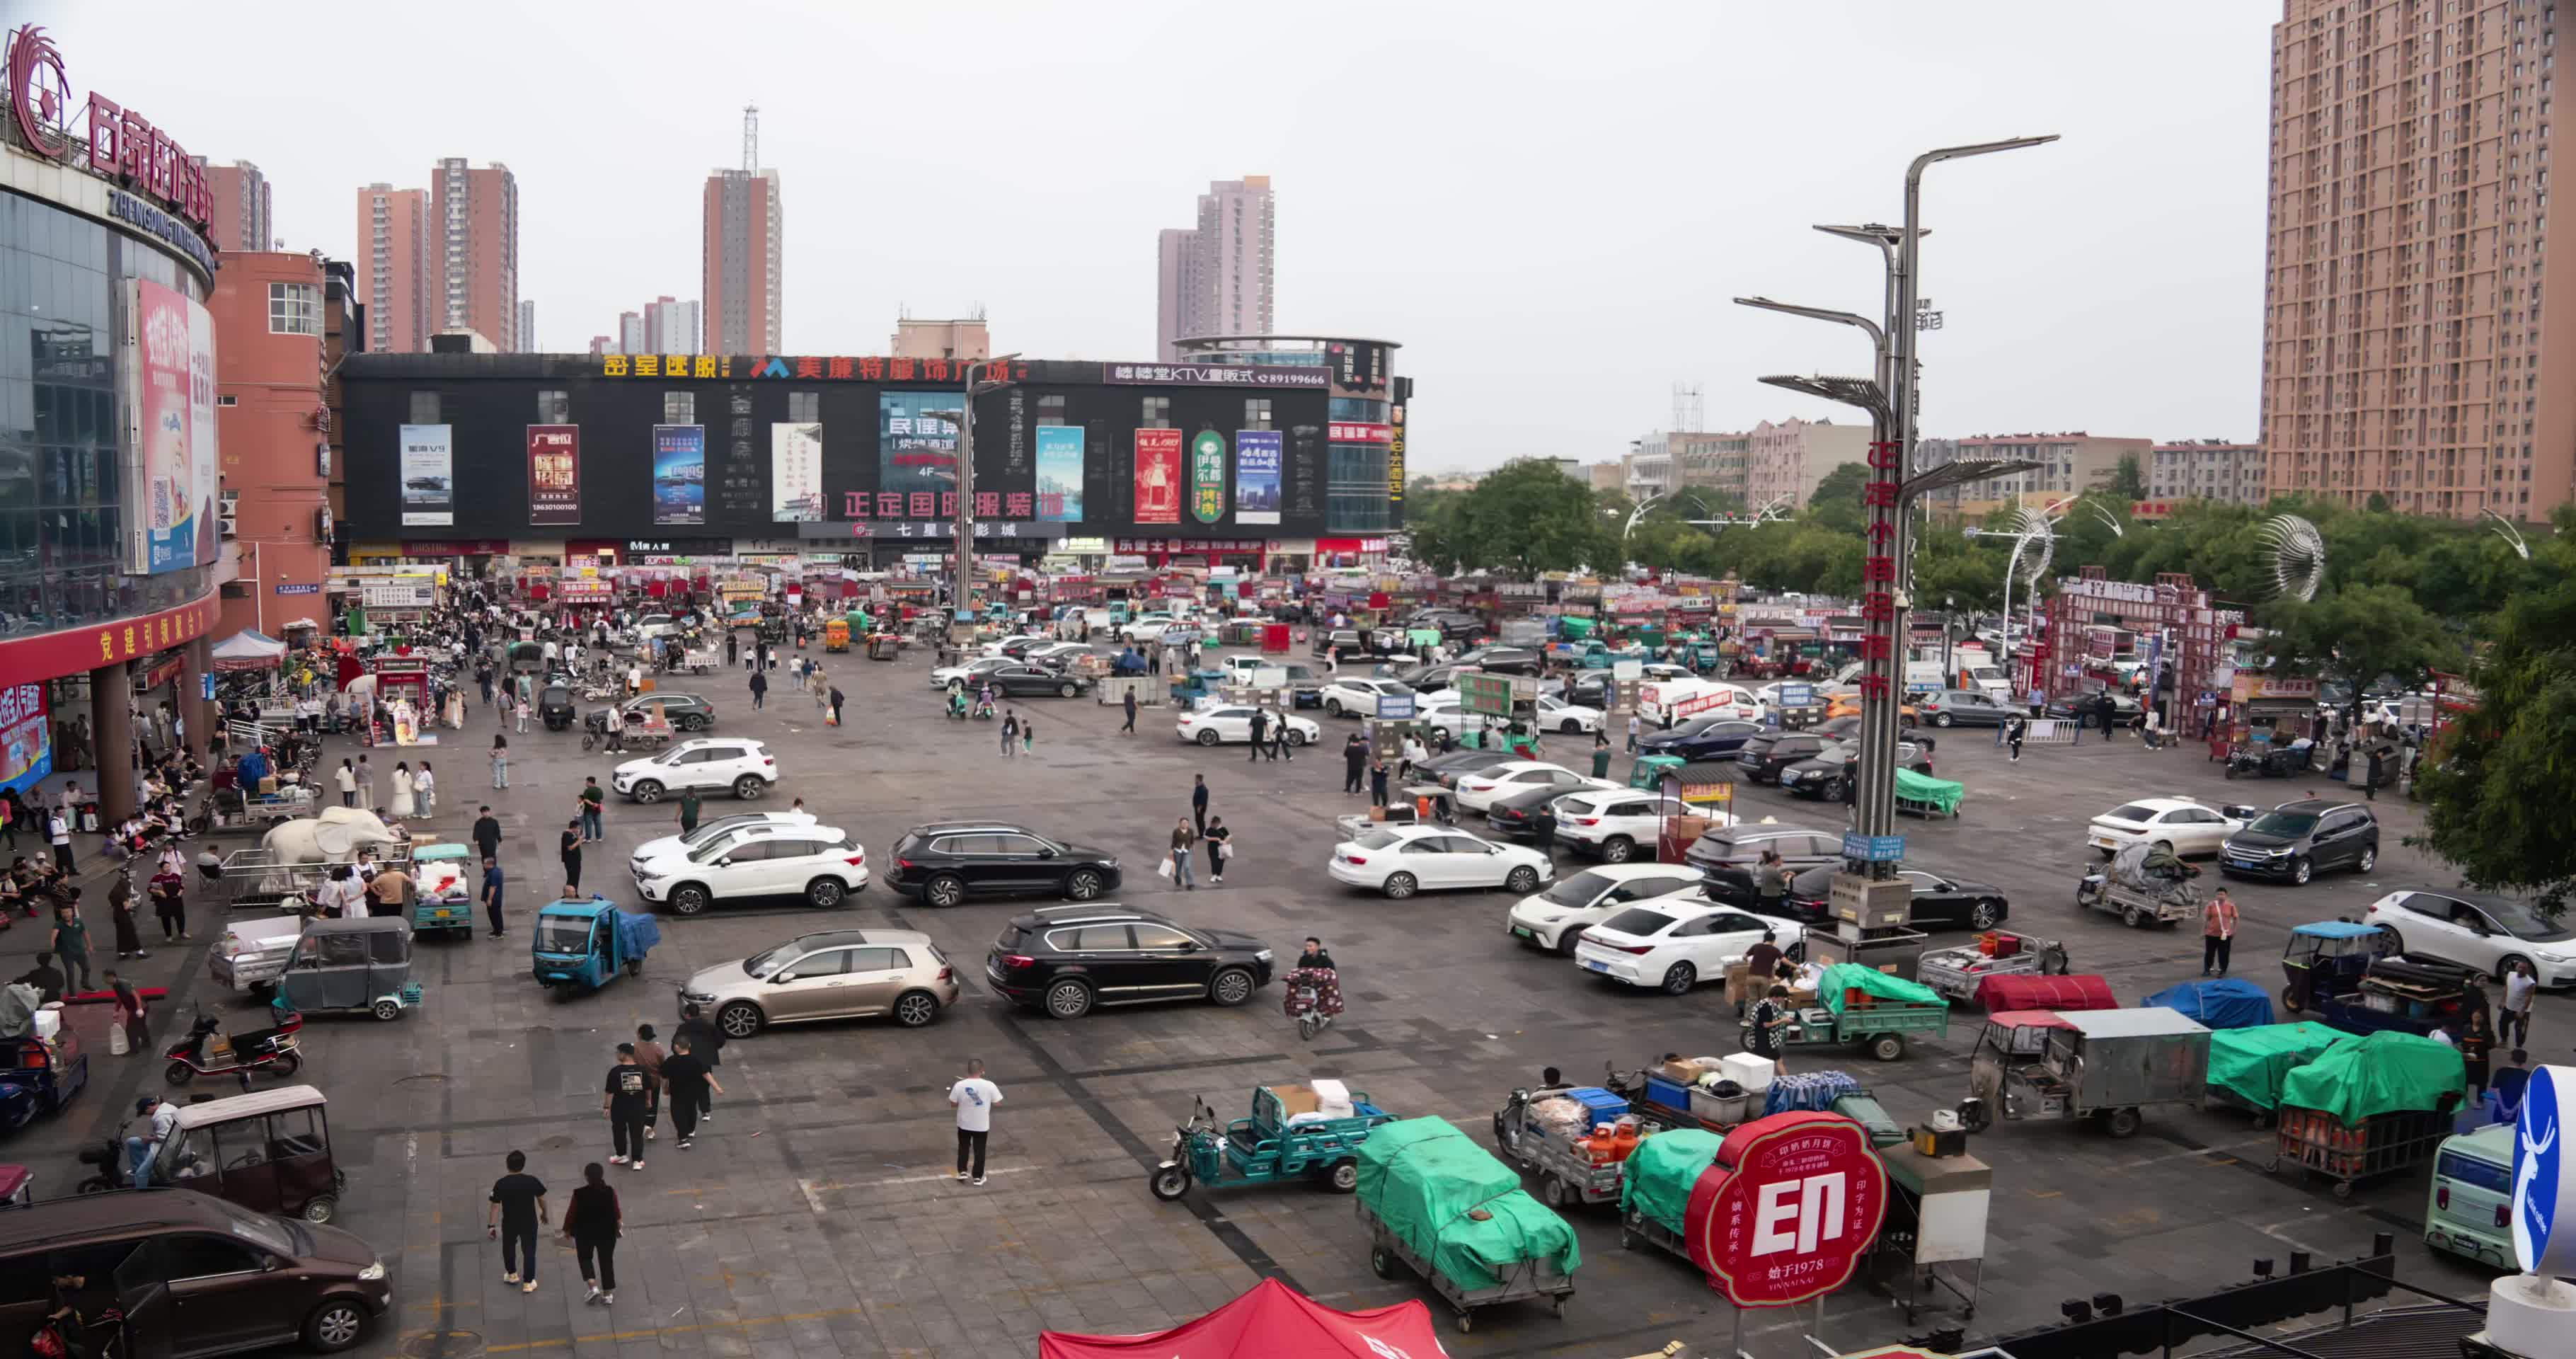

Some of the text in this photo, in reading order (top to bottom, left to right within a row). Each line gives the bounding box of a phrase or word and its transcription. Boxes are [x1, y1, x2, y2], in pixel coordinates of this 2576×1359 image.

[108, 188, 173, 242] ZHENGDING
[604, 354, 716, 379] 密室逃脱
[1269, 372, 1325, 385] 89199666
[532, 433, 573, 447] 广告位
[919, 467, 934, 476] 4F
[844, 490, 1064, 517] 正定国际服装城
[0, 684, 40, 730] 付宝人气街区
[1779, 1138, 1832, 1156] 印奶奶月饼
[1852, 1180, 1867, 1230] 印字为证
[1727, 1200, 1743, 1253] 嫡系传承
[1768, 1258, 1824, 1280] 始于1978
